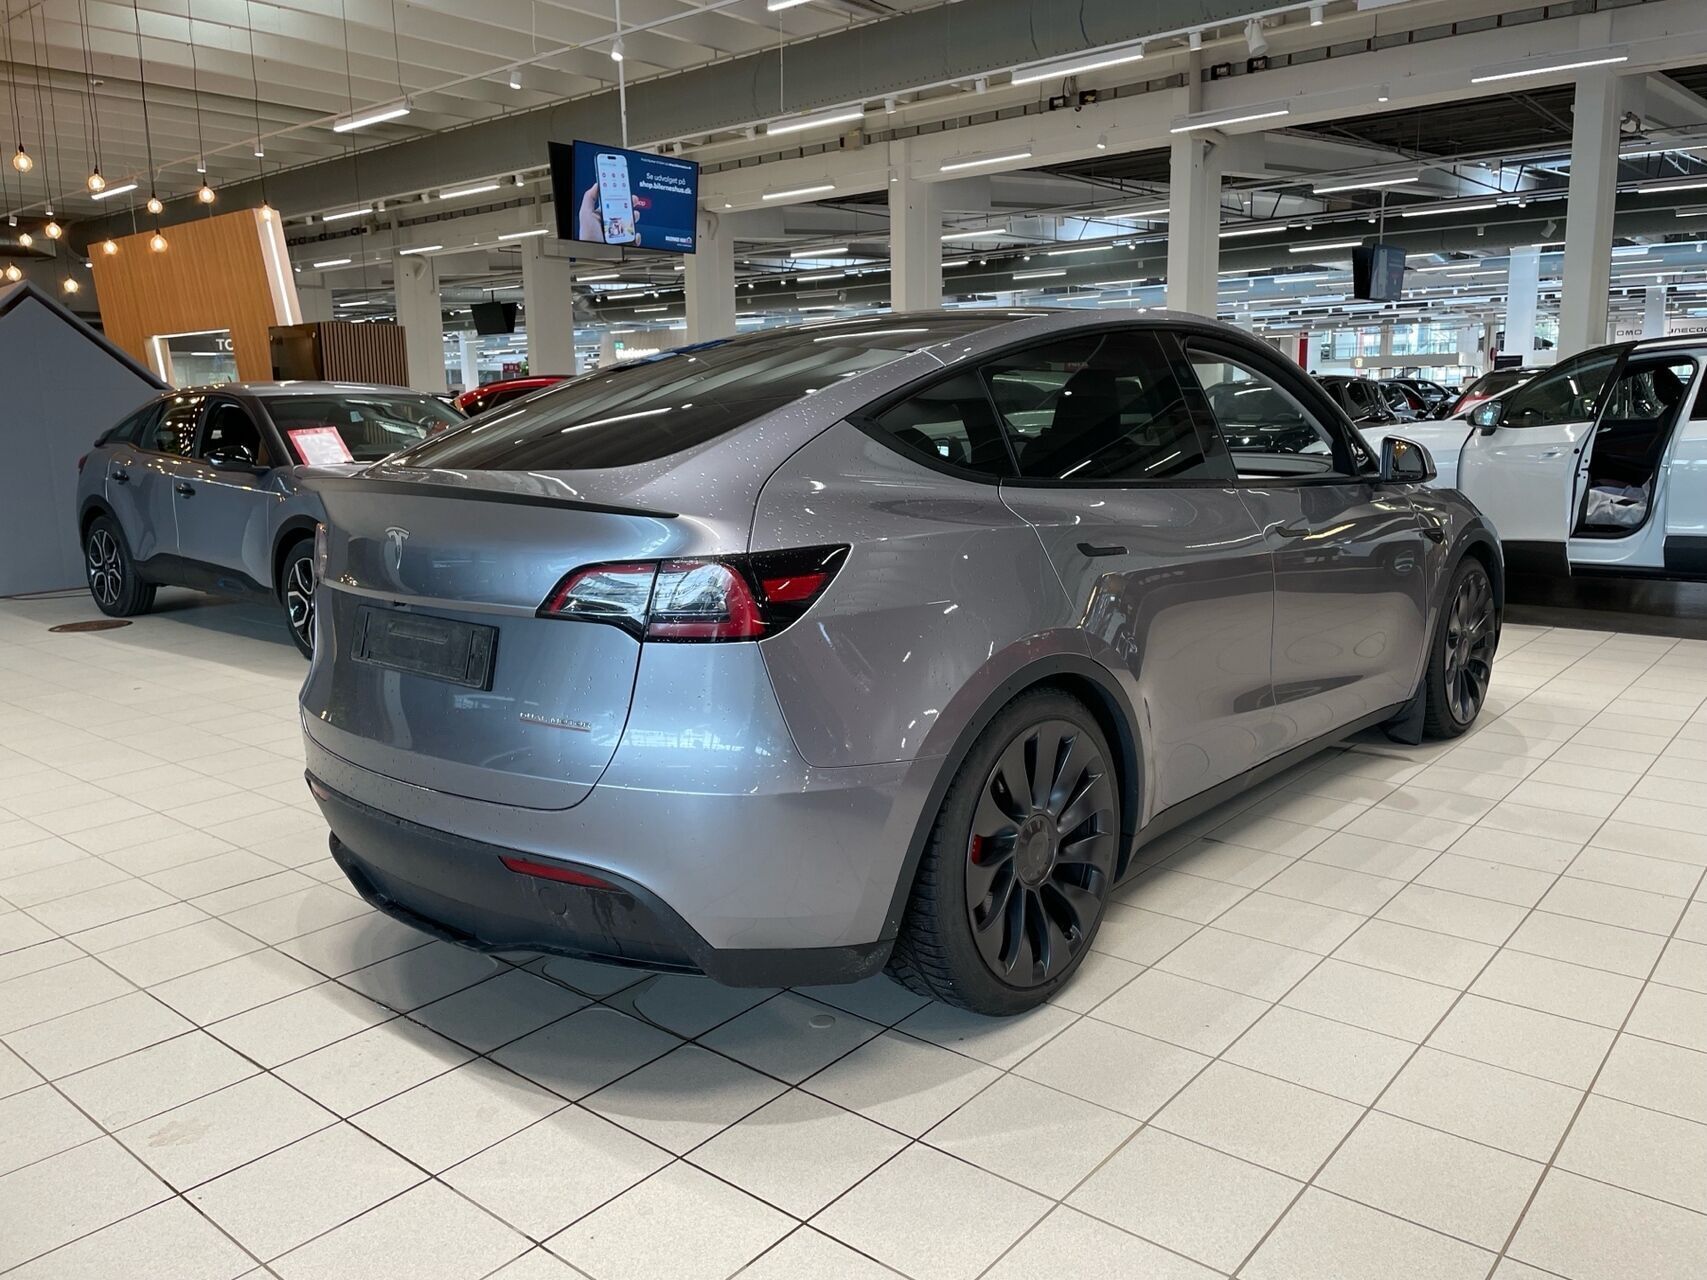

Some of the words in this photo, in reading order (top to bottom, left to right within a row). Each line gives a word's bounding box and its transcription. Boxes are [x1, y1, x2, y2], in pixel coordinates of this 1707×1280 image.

[646, 172, 653, 180] Se
[654, 174, 677, 184] udvalget
[678, 178, 686, 186] på
[639, 181, 692, 194] shop.bilerneshus.dk
